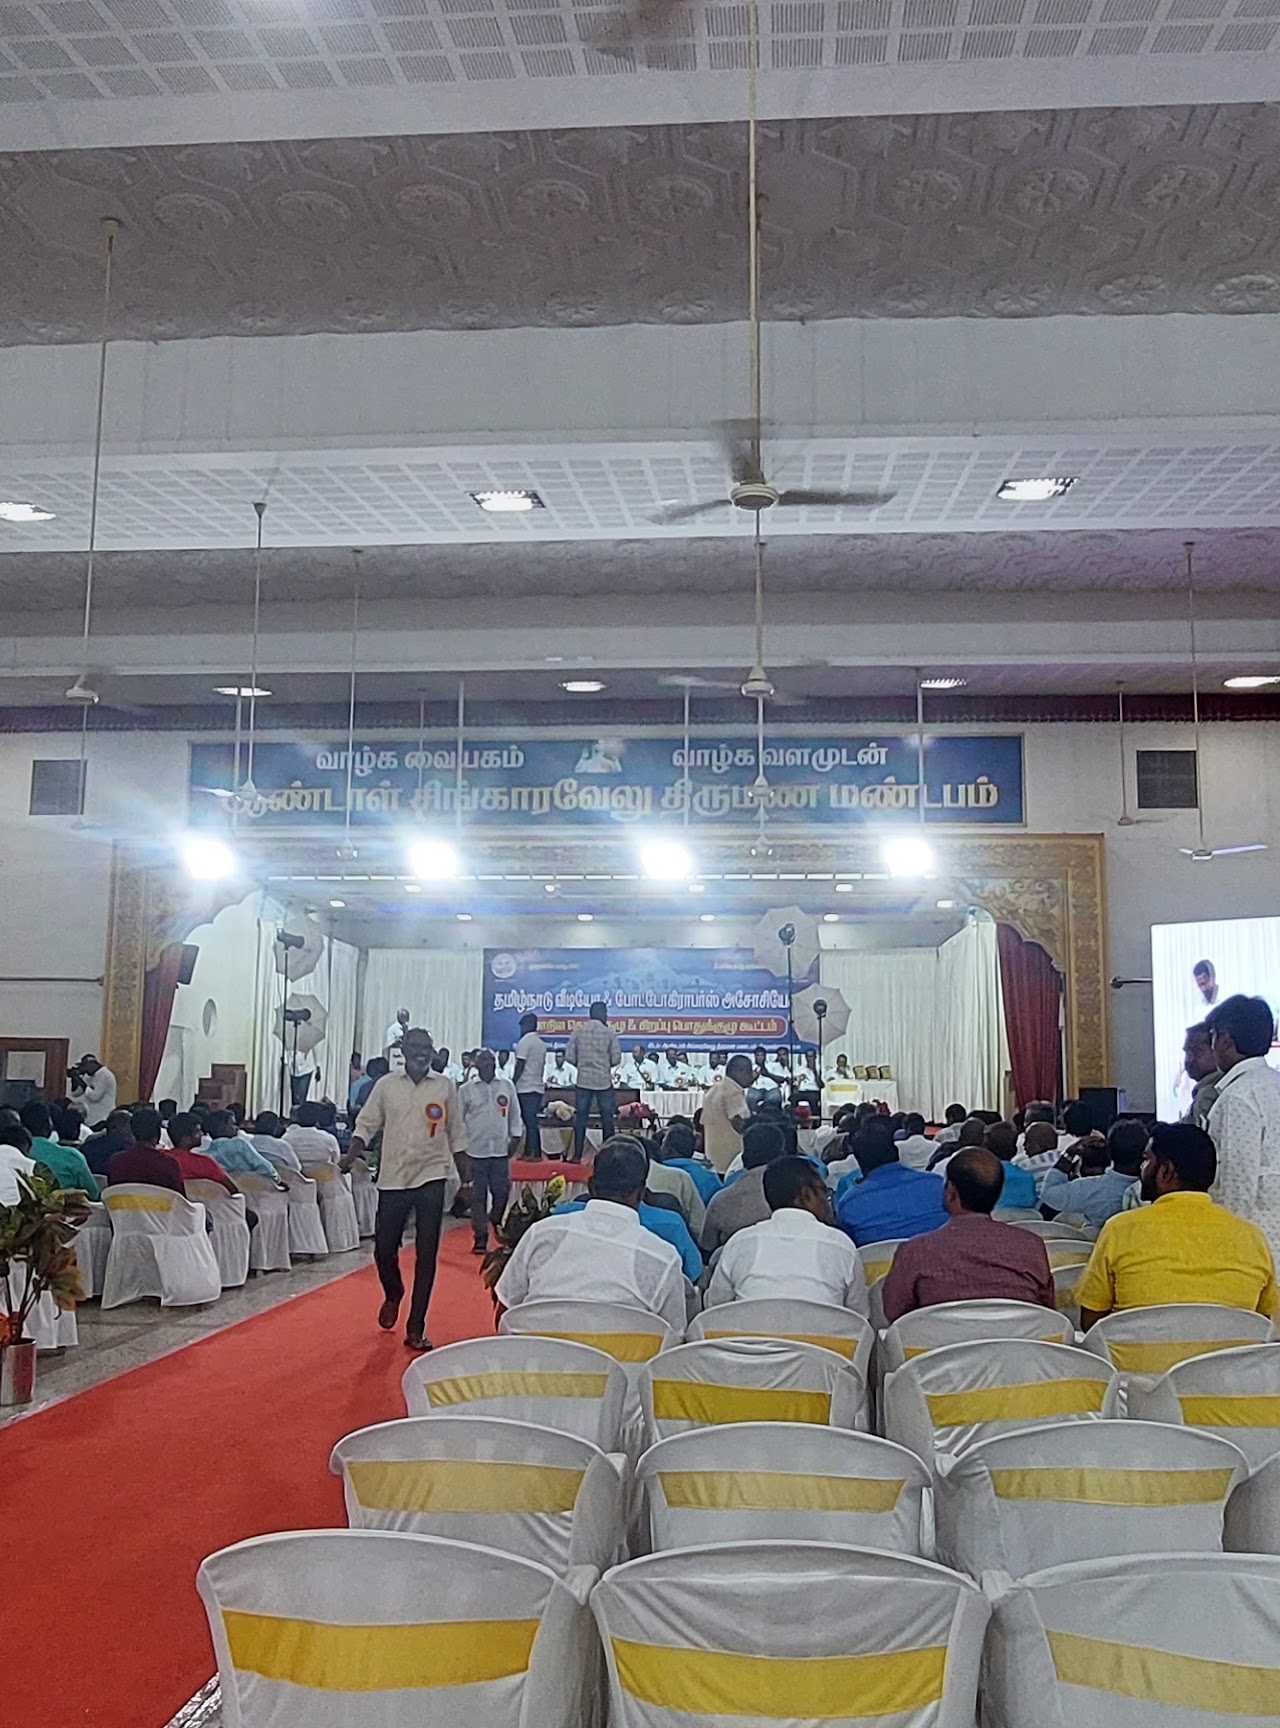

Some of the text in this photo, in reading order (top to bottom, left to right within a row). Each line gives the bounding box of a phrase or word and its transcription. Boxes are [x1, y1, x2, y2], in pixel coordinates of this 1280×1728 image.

[316, 745, 398, 776] வாழ்க
[672, 742, 889, 773] வாழ்க வளமுடன்
[410, 778, 653, 822] சிங்காரவேலு
[828, 775, 1000, 811] மண்டபம்
[493, 988, 554, 1013] தமிழ்நாடு
[721, 988, 790, 1010] அசோசியே
[628, 1019, 638, 1031] &
